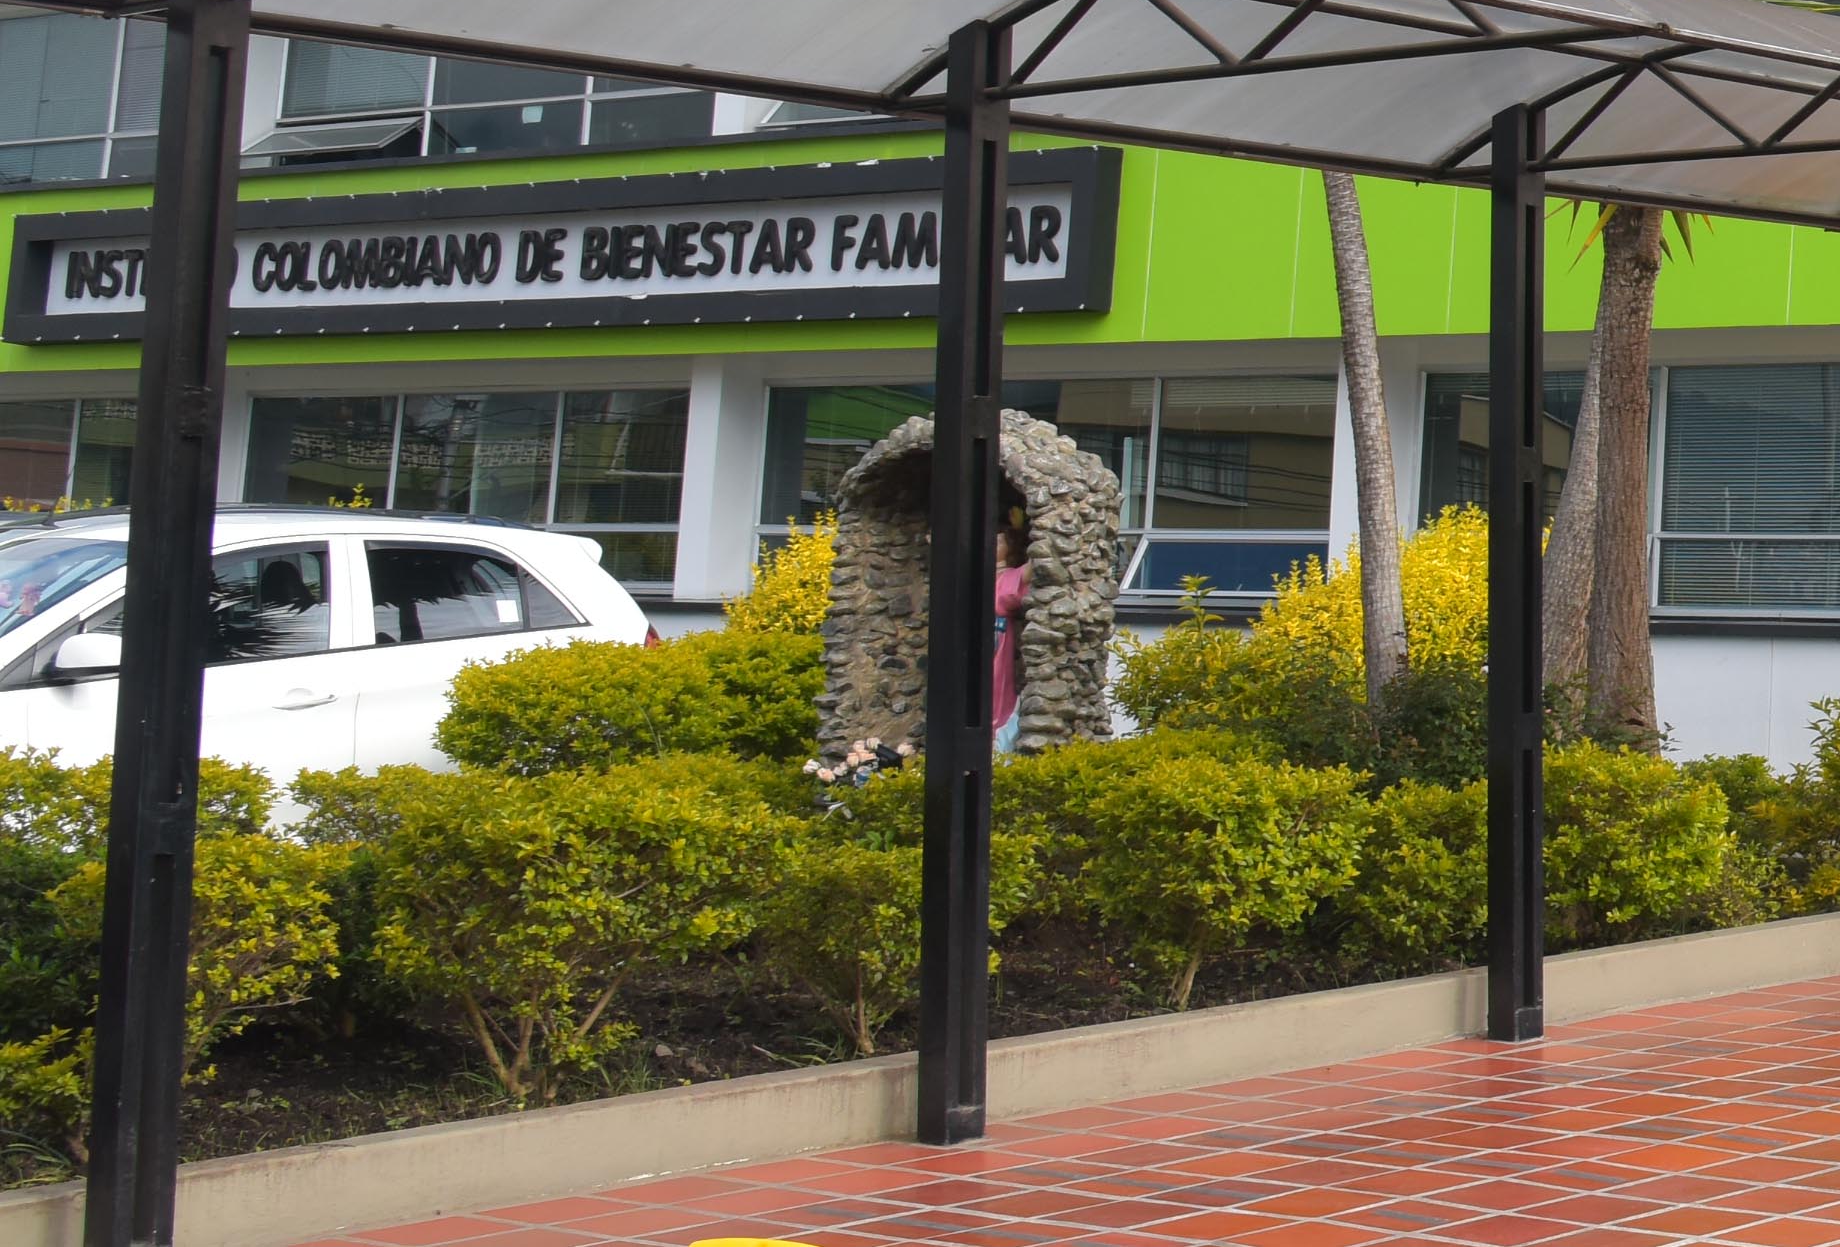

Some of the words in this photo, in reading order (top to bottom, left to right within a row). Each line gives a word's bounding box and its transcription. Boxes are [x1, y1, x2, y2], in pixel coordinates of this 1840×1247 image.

[252, 232, 501, 293] COLOMBIANO
[515, 228, 568, 283] DE
[580, 217, 816, 281] BIENESTAR
[830, 204, 1062, 272] FAMAR
